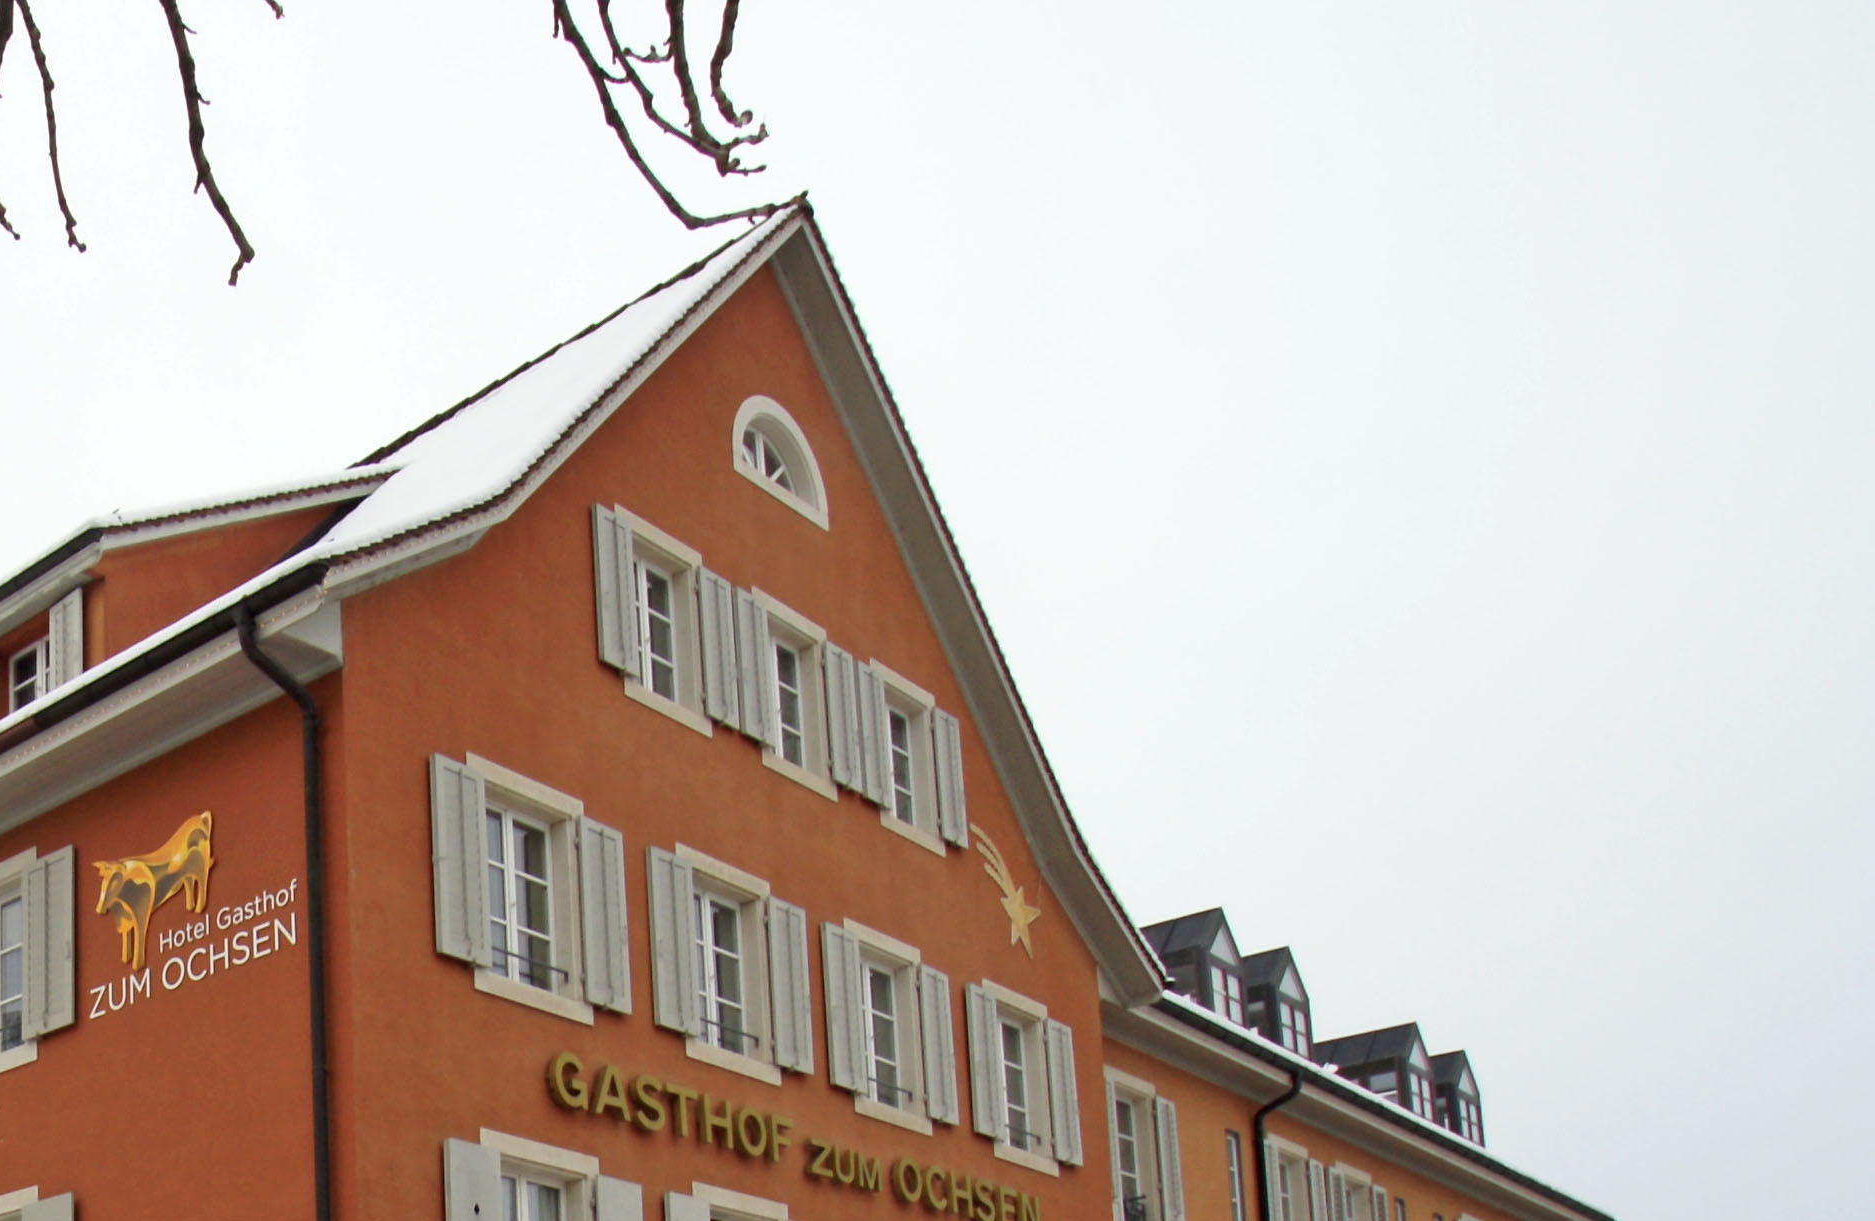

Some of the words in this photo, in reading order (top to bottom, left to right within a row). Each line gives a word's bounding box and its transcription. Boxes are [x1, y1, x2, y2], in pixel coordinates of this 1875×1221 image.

[89, 967, 152, 1020] ZUM
[161, 912, 298, 991] OCHSEN
[159, 914, 210, 951] Hotel
[216, 878, 298, 930] Gasthof
[549, 1051, 794, 1163] GASTHOF
[807, 1138, 883, 1192] ZUM
